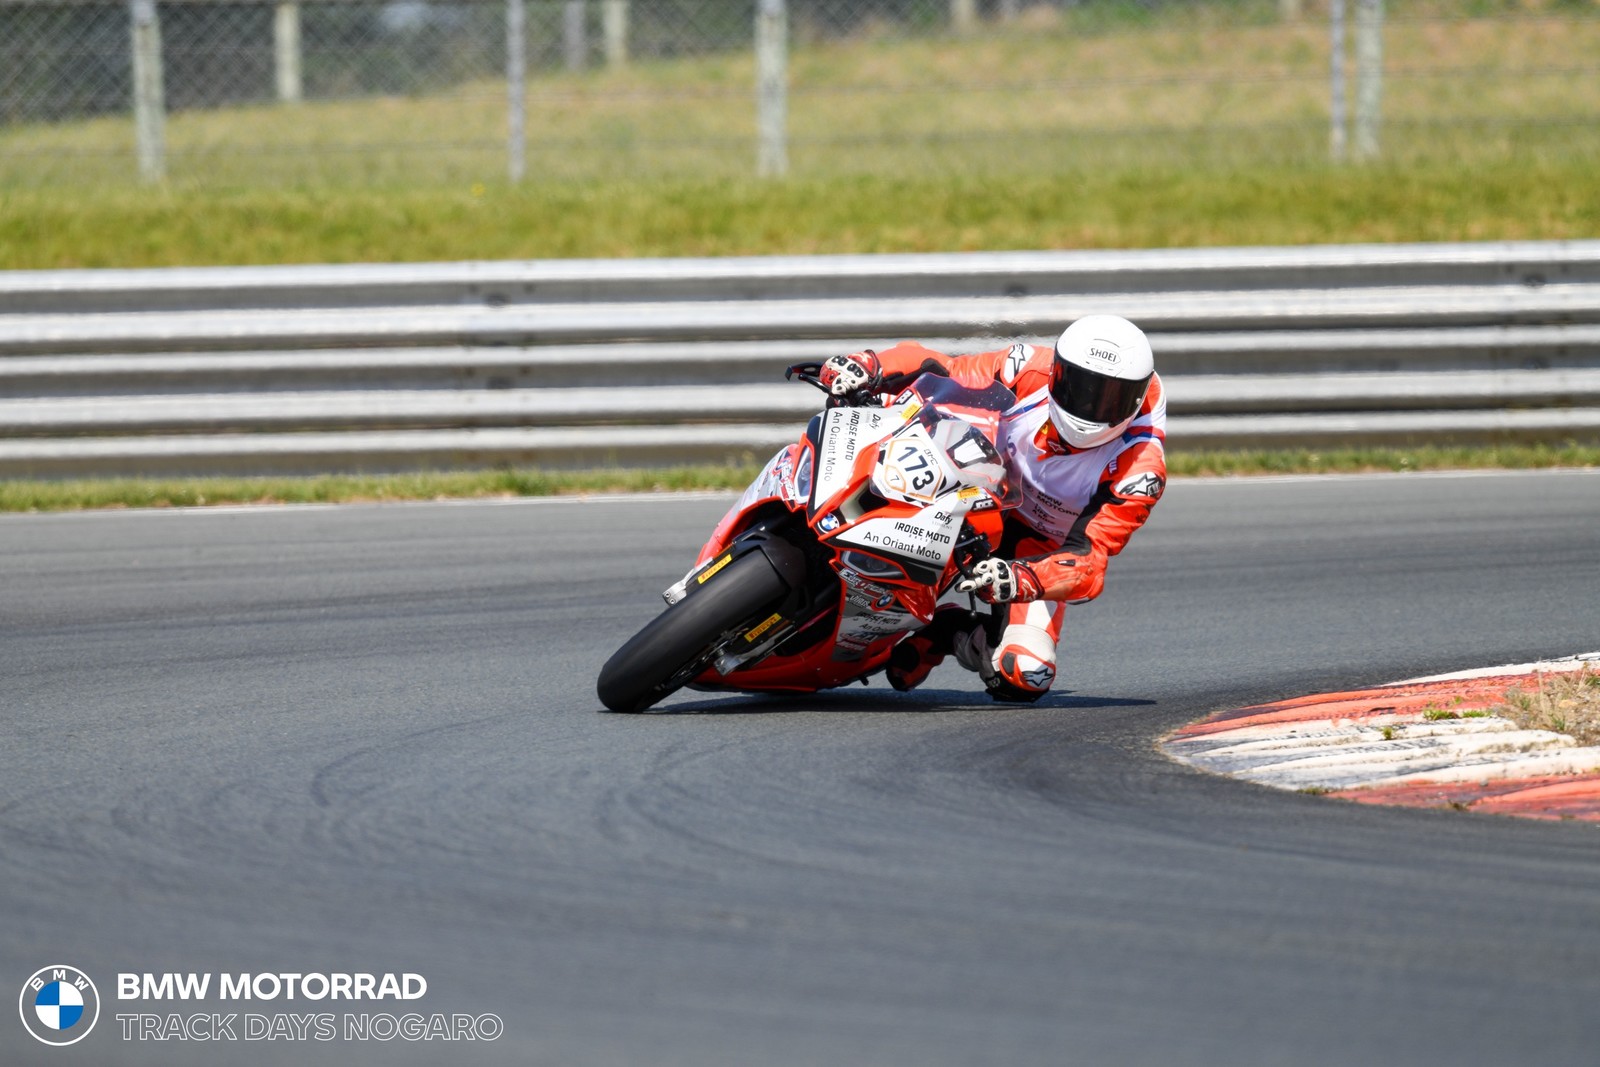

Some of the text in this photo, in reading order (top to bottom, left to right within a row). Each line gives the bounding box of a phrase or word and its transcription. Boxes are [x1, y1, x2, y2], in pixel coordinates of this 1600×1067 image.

[1089, 347, 1117, 362] SHOEI
[848, 410, 861, 437] IROISE
[824, 411, 843, 482] An Oriant Moto
[844, 437, 856, 461] MOTO
[897, 446, 935, 491] 173
[934, 511, 953, 525] Dafy
[863, 531, 879, 543] An
[882, 536, 914, 553] Oriant
[916, 545, 941, 560] Moto
[894, 522, 925, 537] IROISE
[925, 530, 951, 544] MOTO
